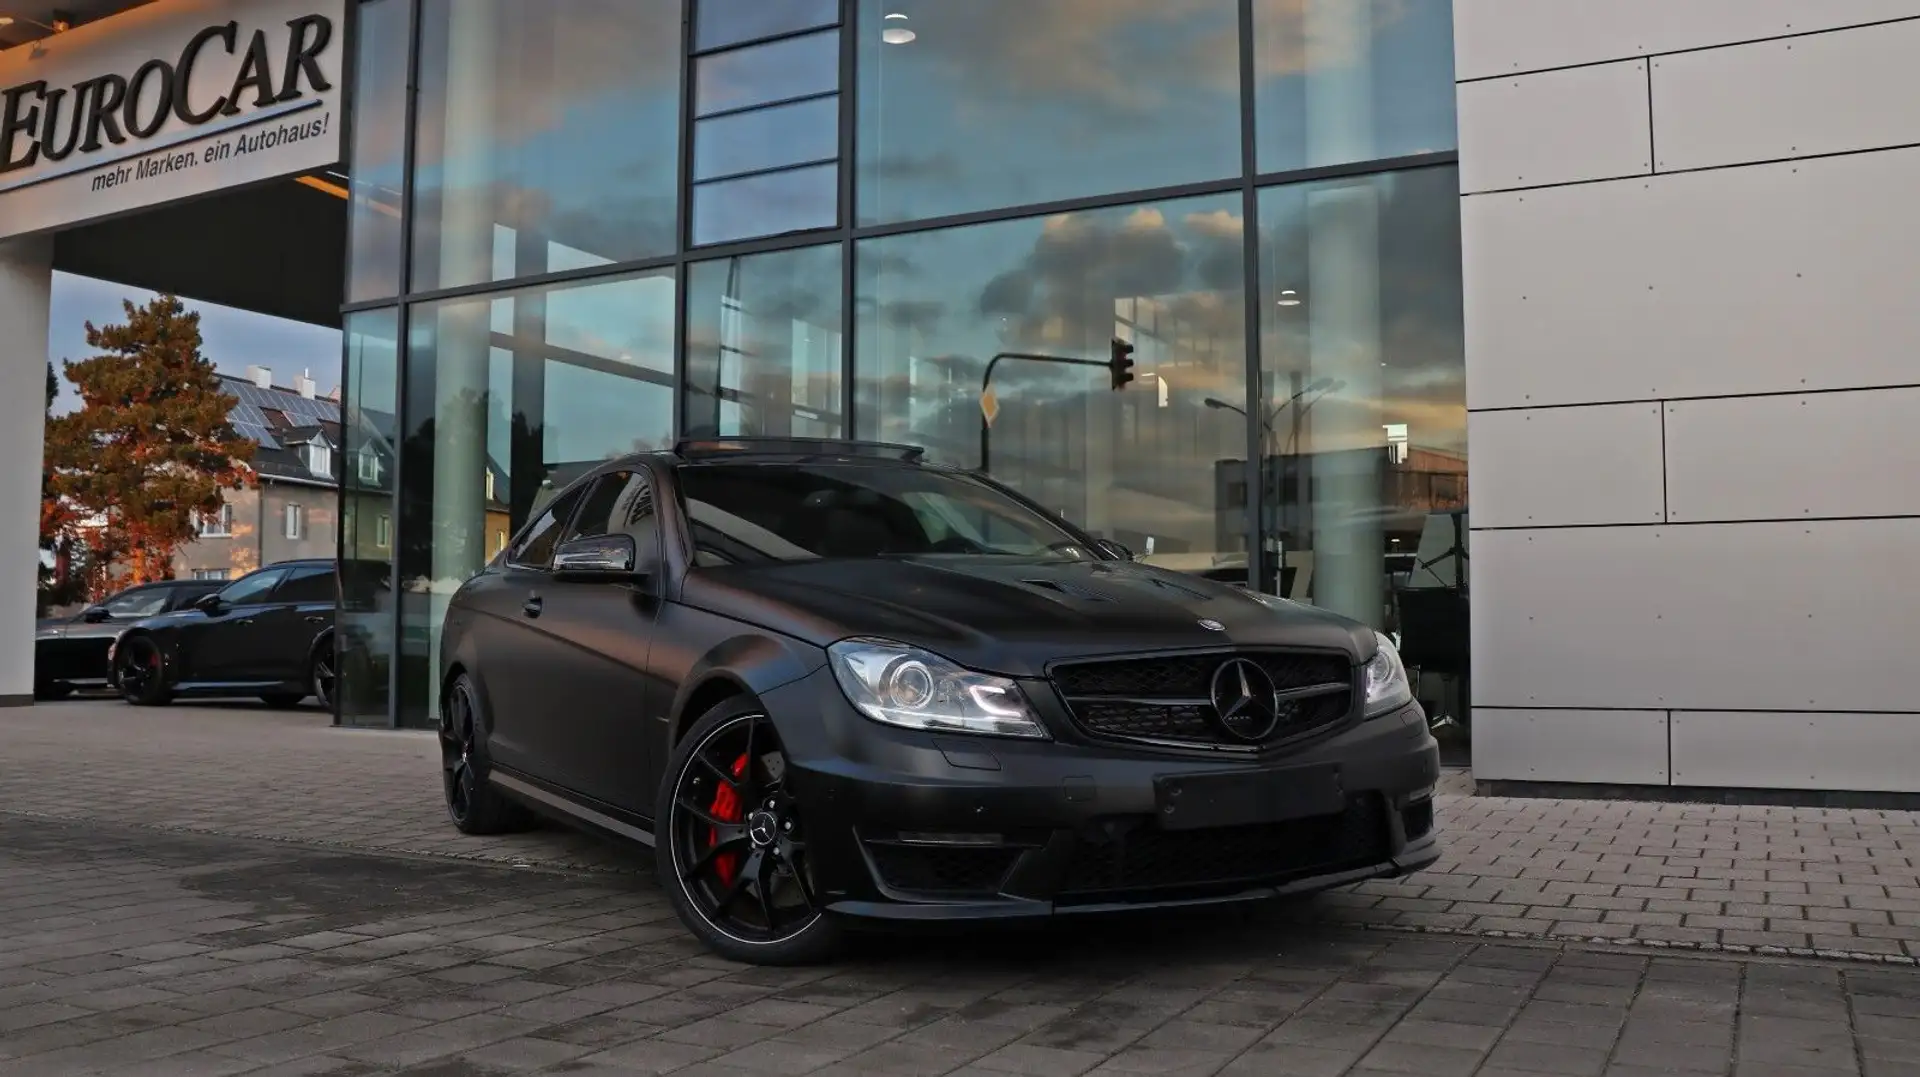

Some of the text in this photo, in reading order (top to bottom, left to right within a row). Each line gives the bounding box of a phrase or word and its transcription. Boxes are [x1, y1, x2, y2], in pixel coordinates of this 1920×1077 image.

[91, 112, 330, 192] mehr Marken. ein Autohaus!
